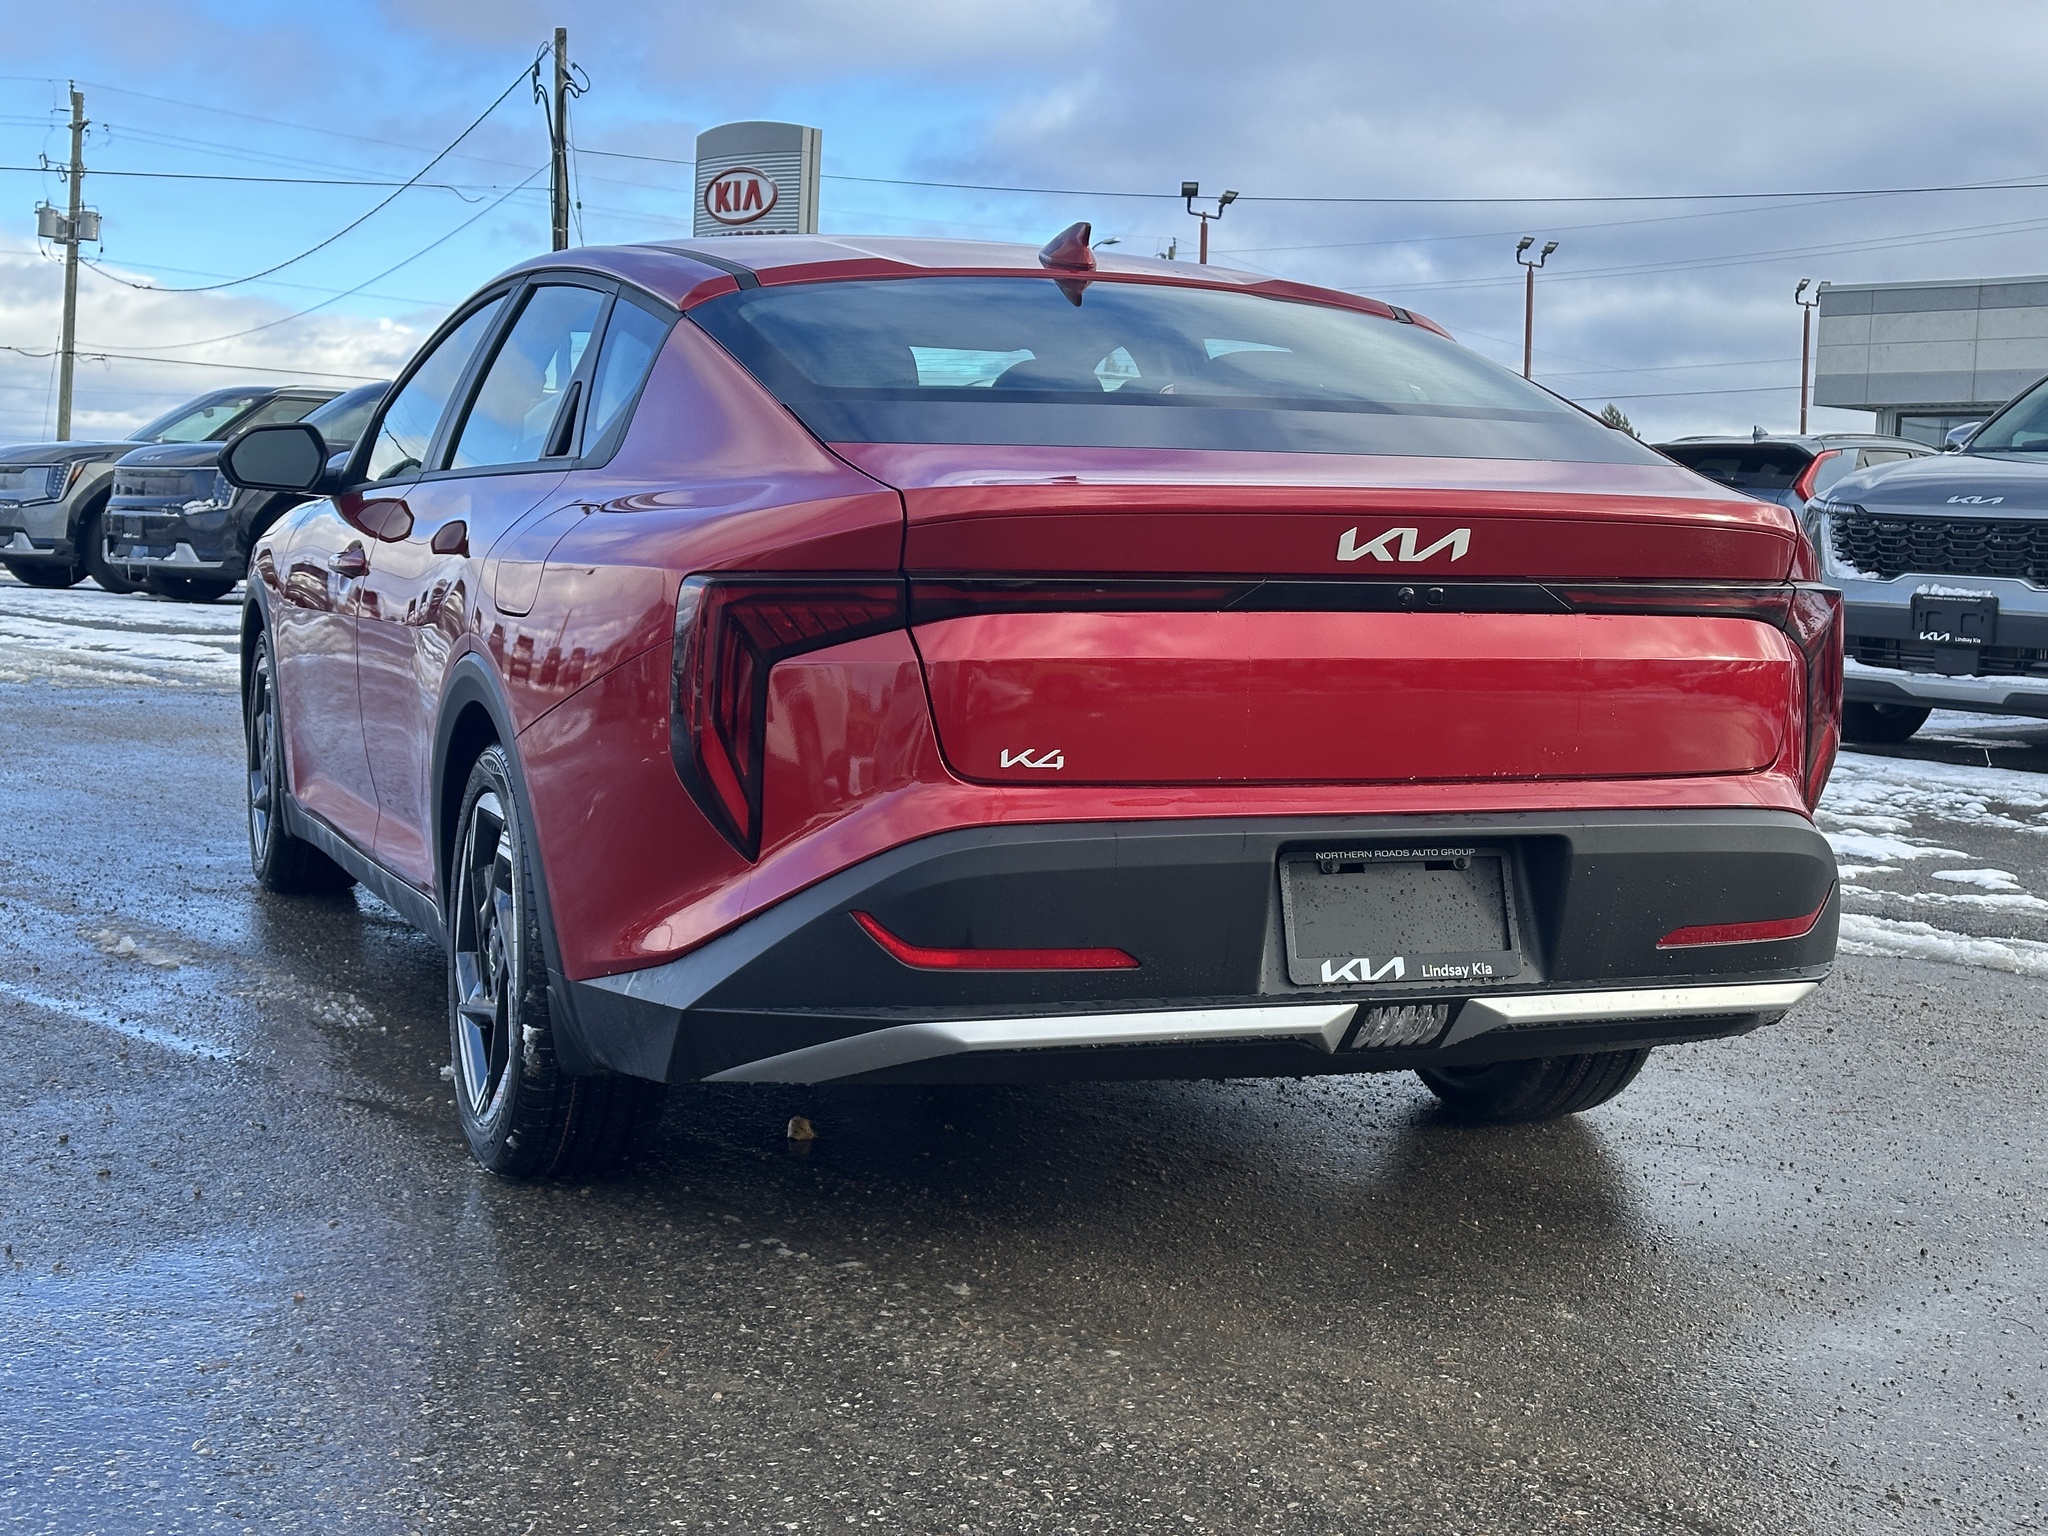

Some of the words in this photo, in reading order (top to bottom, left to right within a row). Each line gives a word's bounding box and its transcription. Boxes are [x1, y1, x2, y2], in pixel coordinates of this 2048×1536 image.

[714, 179, 763, 213] KIA
[1337, 527, 1471, 562] KIA
[1000, 748, 1064, 770] K4
[1315, 851, 1372, 860] NORTHERN
[1374, 849, 1410, 858] ROADS
[1411, 848, 1439, 857] AUTO
[1440, 847, 1476, 856] GROUP
[1320, 956, 1405, 982] KIA
[1422, 963, 1469, 979] Lindsay
[1471, 962, 1493, 975] Kia
